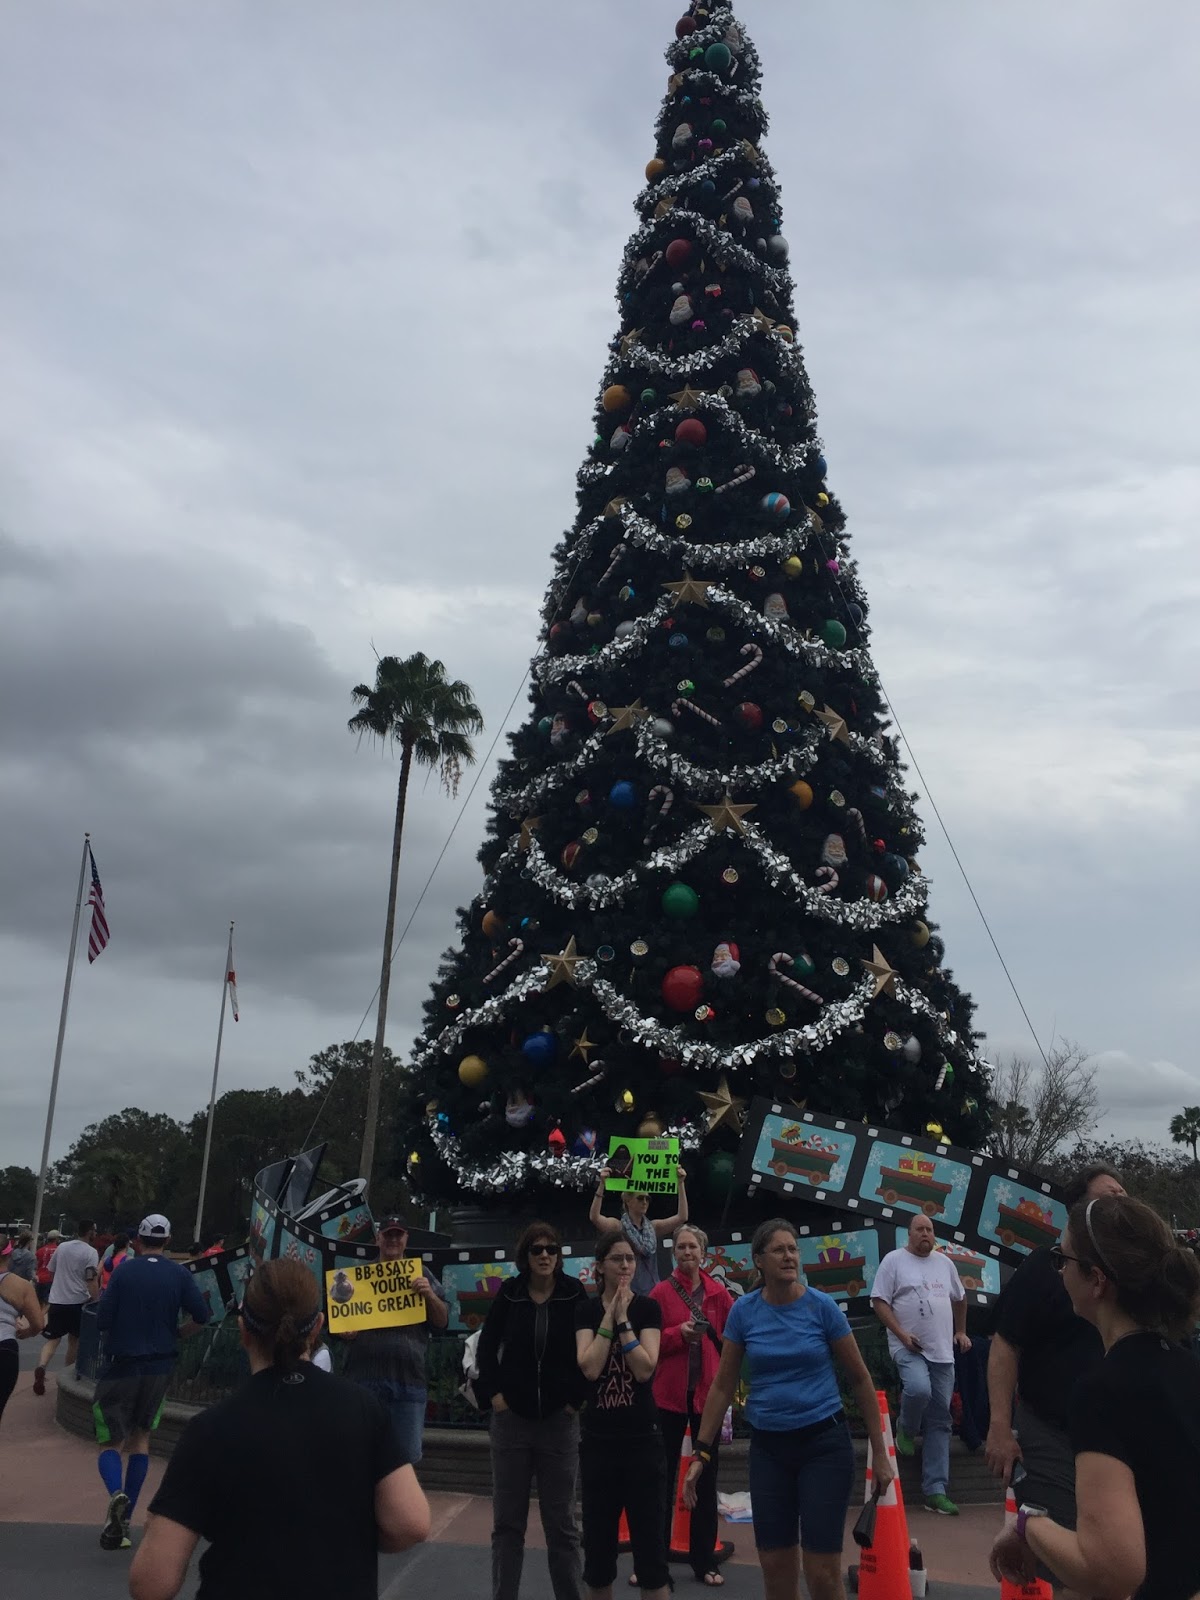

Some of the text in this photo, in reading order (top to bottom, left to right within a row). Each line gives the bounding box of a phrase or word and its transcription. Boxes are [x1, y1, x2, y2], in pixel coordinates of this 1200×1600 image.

[637, 1153, 680, 1165] YOU TO
[646, 1168, 670, 1179] THE
[626, 1180, 676, 1193] FINNISH
[355, 1260, 415, 1281] BB-8 SAYS
[331, 1292, 423, 1319] DOING GREAT!
[596, 1391, 635, 1409] AWAY
